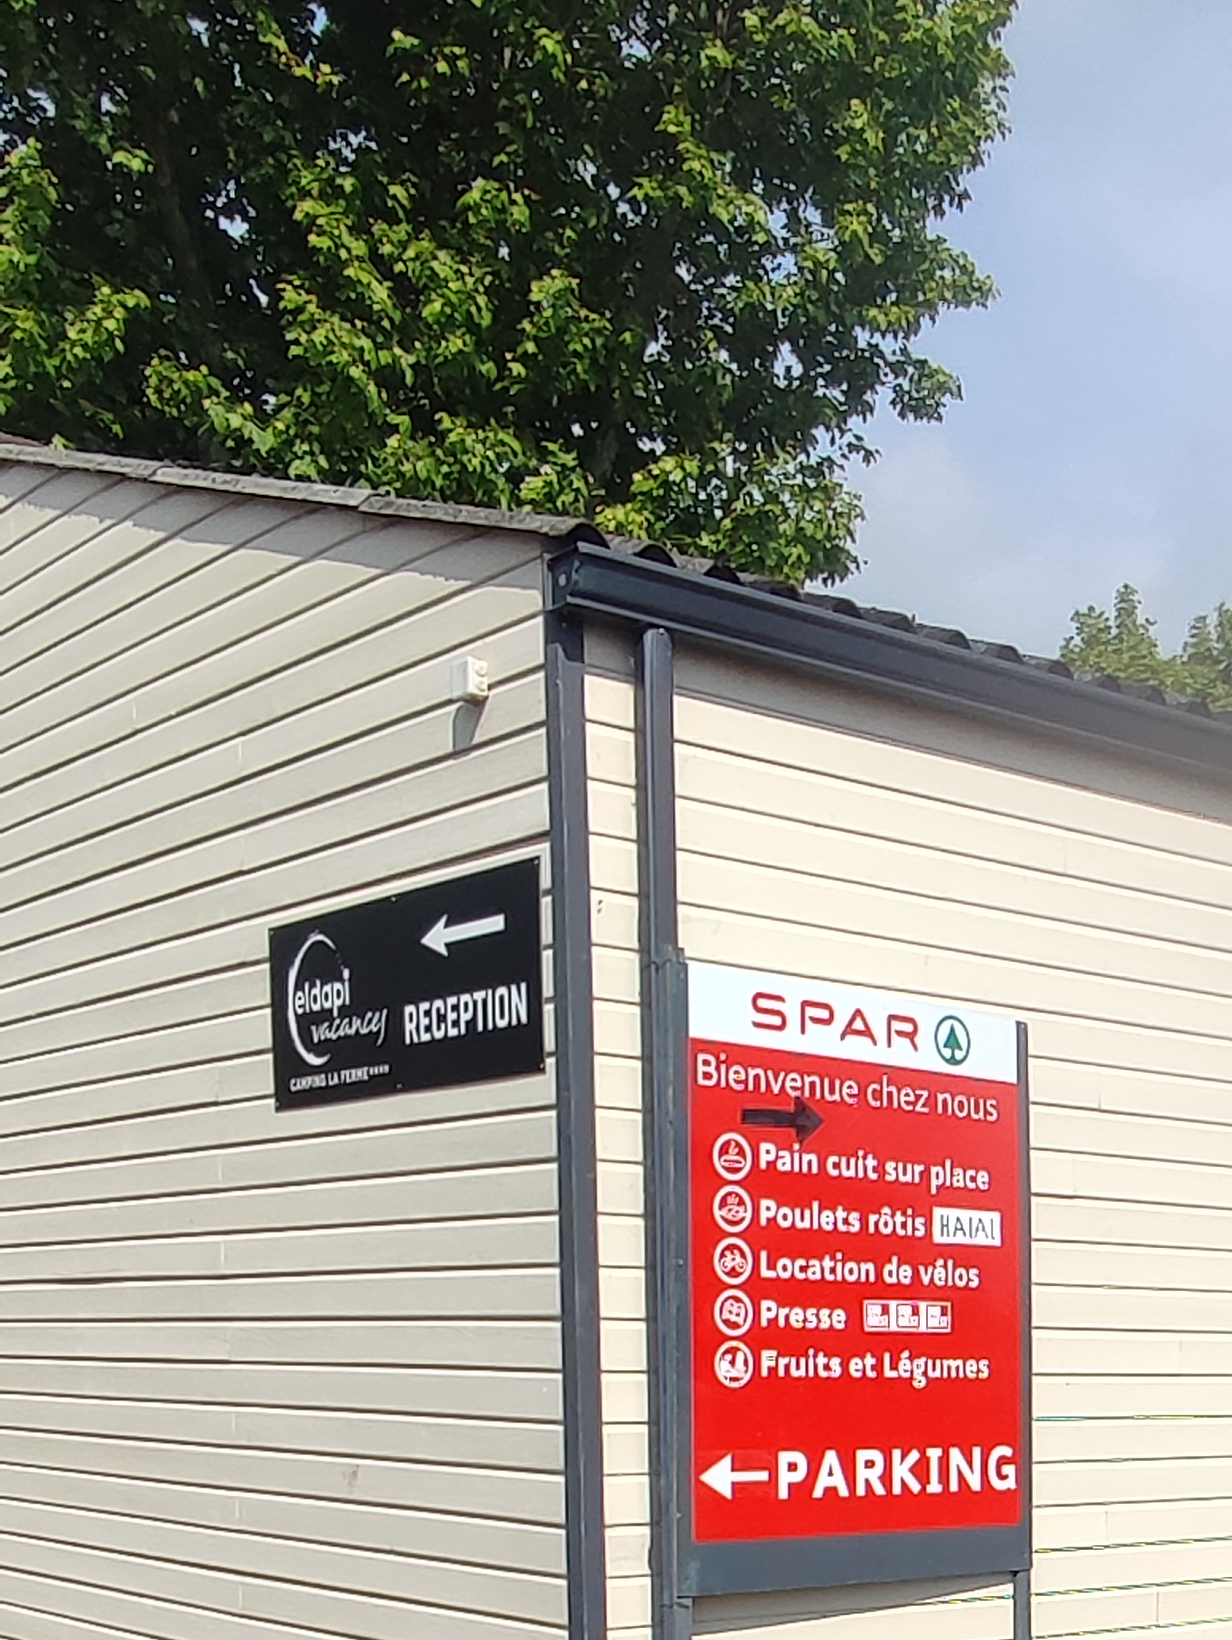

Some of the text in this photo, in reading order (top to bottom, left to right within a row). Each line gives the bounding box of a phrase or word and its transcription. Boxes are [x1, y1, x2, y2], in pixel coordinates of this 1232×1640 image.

[295, 968, 350, 1017] eldapi
[404, 982, 528, 1045] RECEPTION
[751, 991, 919, 1053] SPAR
[696, 1053, 999, 1122] Bienvenue chez nous
[759, 1143, 990, 1195] Pain cuit sur place
[759, 1199, 860, 1234] Poulets
[868, 1206, 926, 1238] rôtis
[760, 1251, 980, 1288] Location de vélos
[760, 1300, 847, 1330] Presse
[760, 1348, 990, 1389] Fruits et Légumes
[777, 1445, 1018, 1500] PARKING
